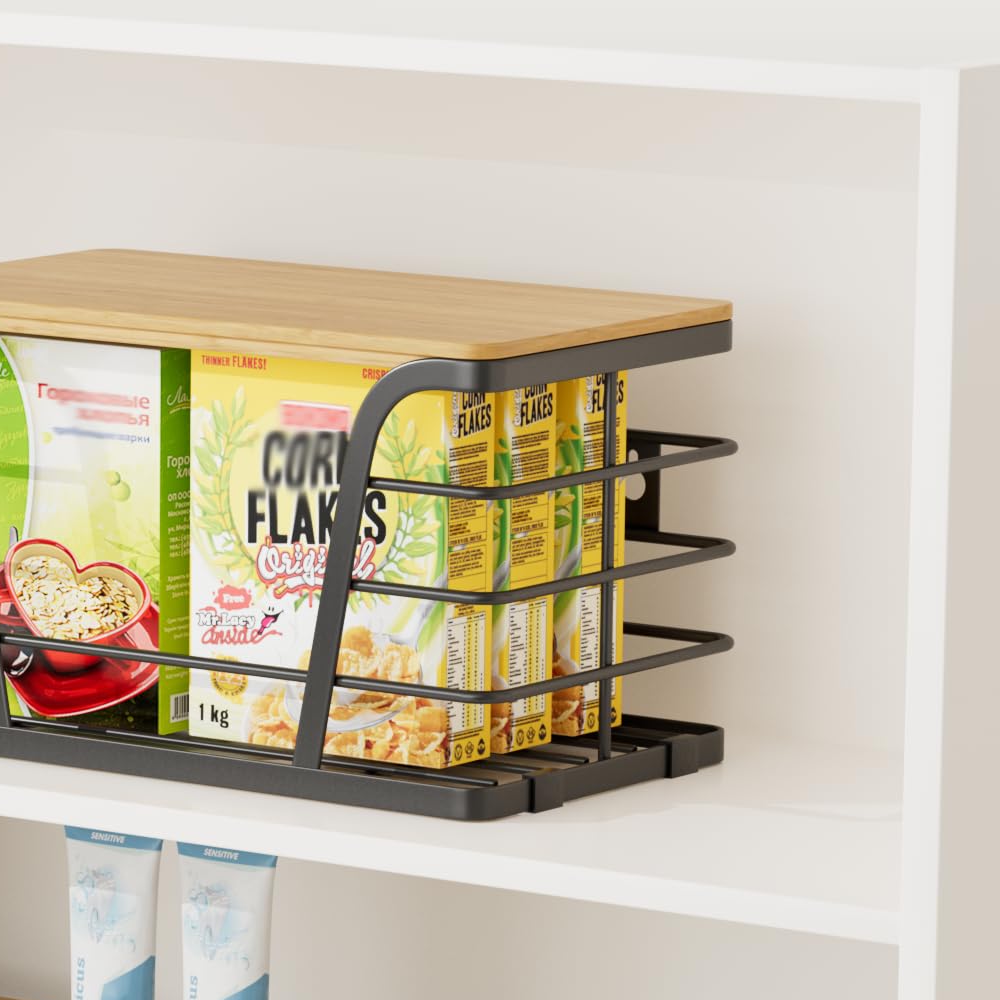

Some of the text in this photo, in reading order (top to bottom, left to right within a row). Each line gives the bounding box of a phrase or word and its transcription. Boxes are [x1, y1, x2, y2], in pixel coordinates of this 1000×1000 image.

[202, 354, 267, 370] THINNER FLAKES!
[458, 403, 491, 438] FLAKES
[520, 393, 553, 427] FLAKES
[248, 489, 387, 546] FLAKS
[199, 703, 229, 729] 1 kg
[90, 831, 125, 844] SENSITIVE
[203, 848, 239, 860] SENSITIVE
